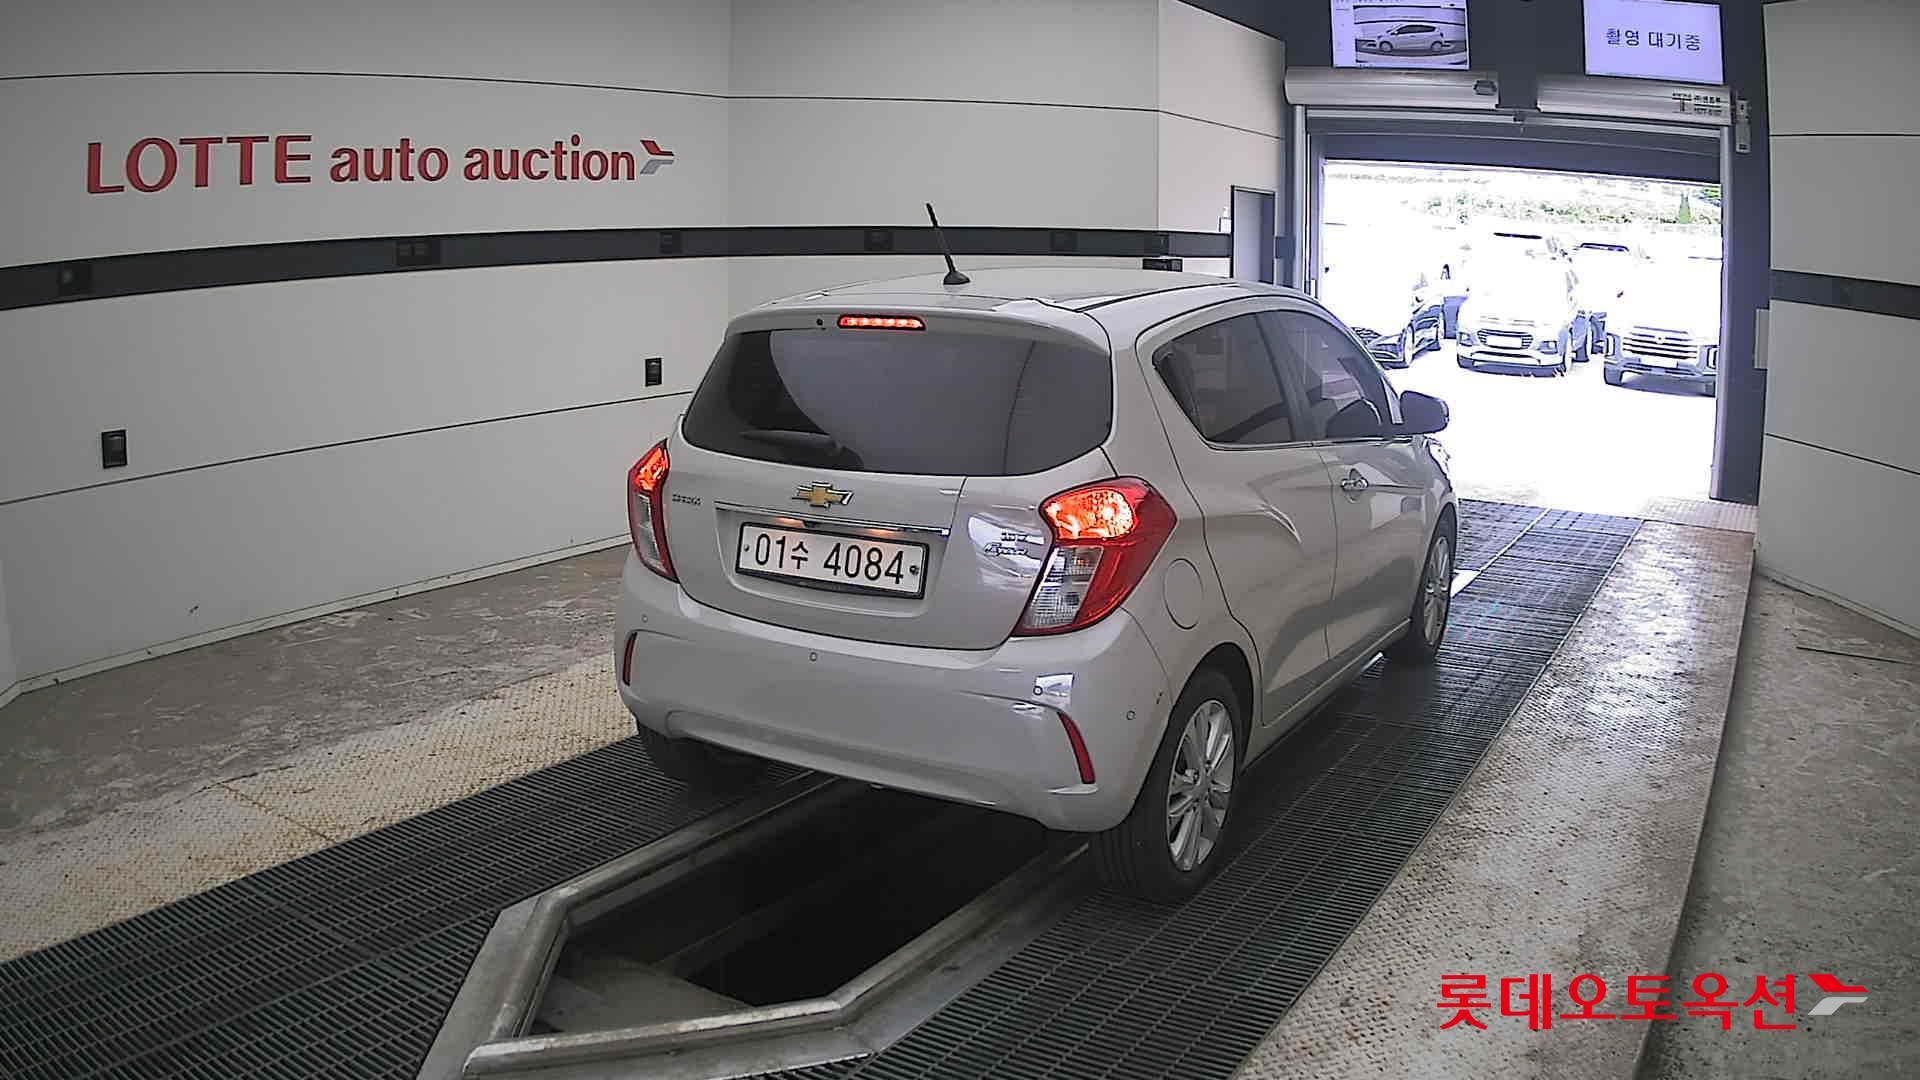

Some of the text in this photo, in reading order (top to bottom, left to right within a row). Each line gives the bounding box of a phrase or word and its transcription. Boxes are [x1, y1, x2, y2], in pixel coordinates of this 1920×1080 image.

[1648, 31, 1701, 52] 대기중
[87, 134, 636, 194] LOTTE auto auction
[755, 533, 905, 585] 01수 4084
